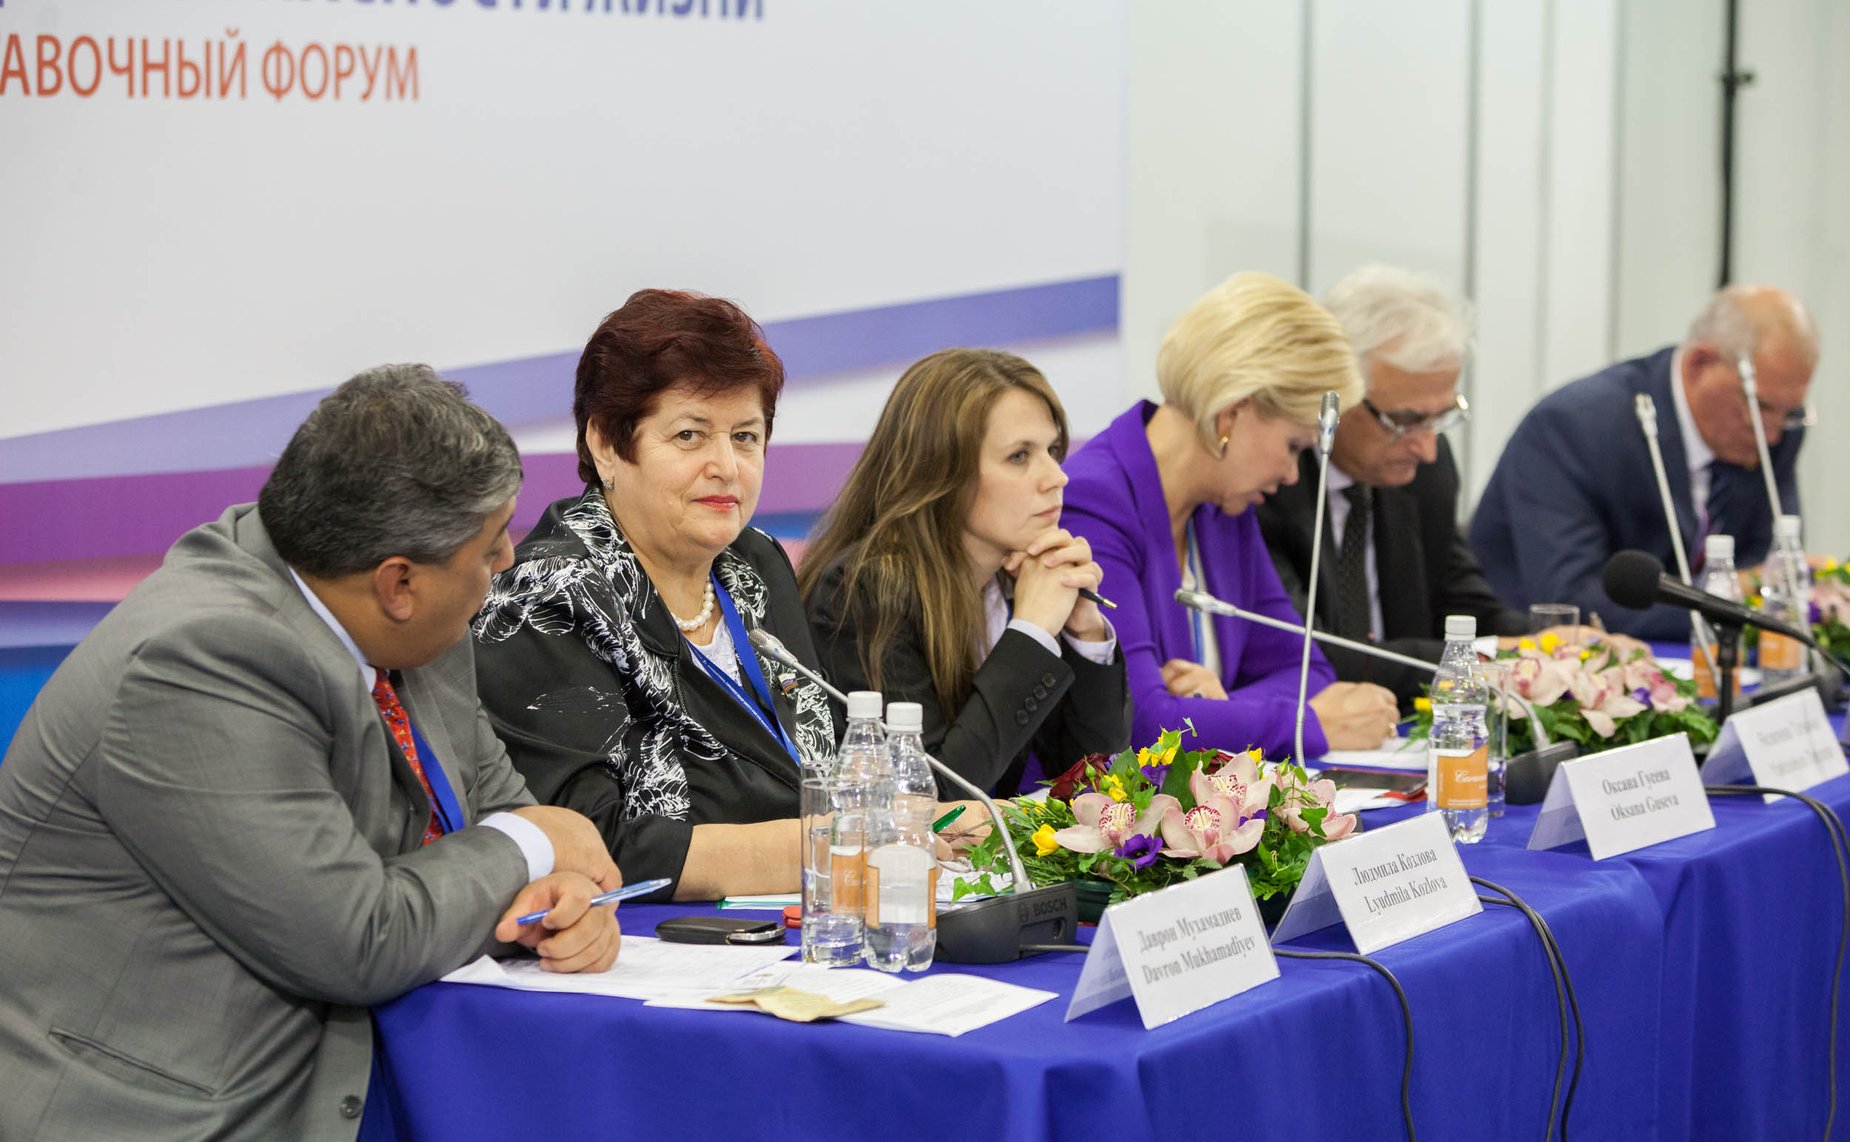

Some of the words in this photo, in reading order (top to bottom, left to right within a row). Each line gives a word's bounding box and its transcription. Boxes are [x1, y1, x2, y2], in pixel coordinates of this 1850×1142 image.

[0, 28, 247, 98] АВОЧНЫЙ
[261, 40, 419, 101] ФОРУМ
[1602, 777, 1639, 795] Оксана
[1610, 802, 1646, 821] Oksana
[1352, 861, 1399, 886] Людмила
[1397, 849, 1437, 872] Козлова
[1033, 897, 1067, 917] BOSCH
[1364, 886, 1411, 915] Lyudmila
[1409, 876, 1448, 898] Kozlova
[1138, 926, 1179, 953] Даврон
[1176, 907, 1242, 940] Мухамадиев
[1141, 961, 1182, 985] Davron
[1181, 936, 1256, 970] Mukhamadiyev
